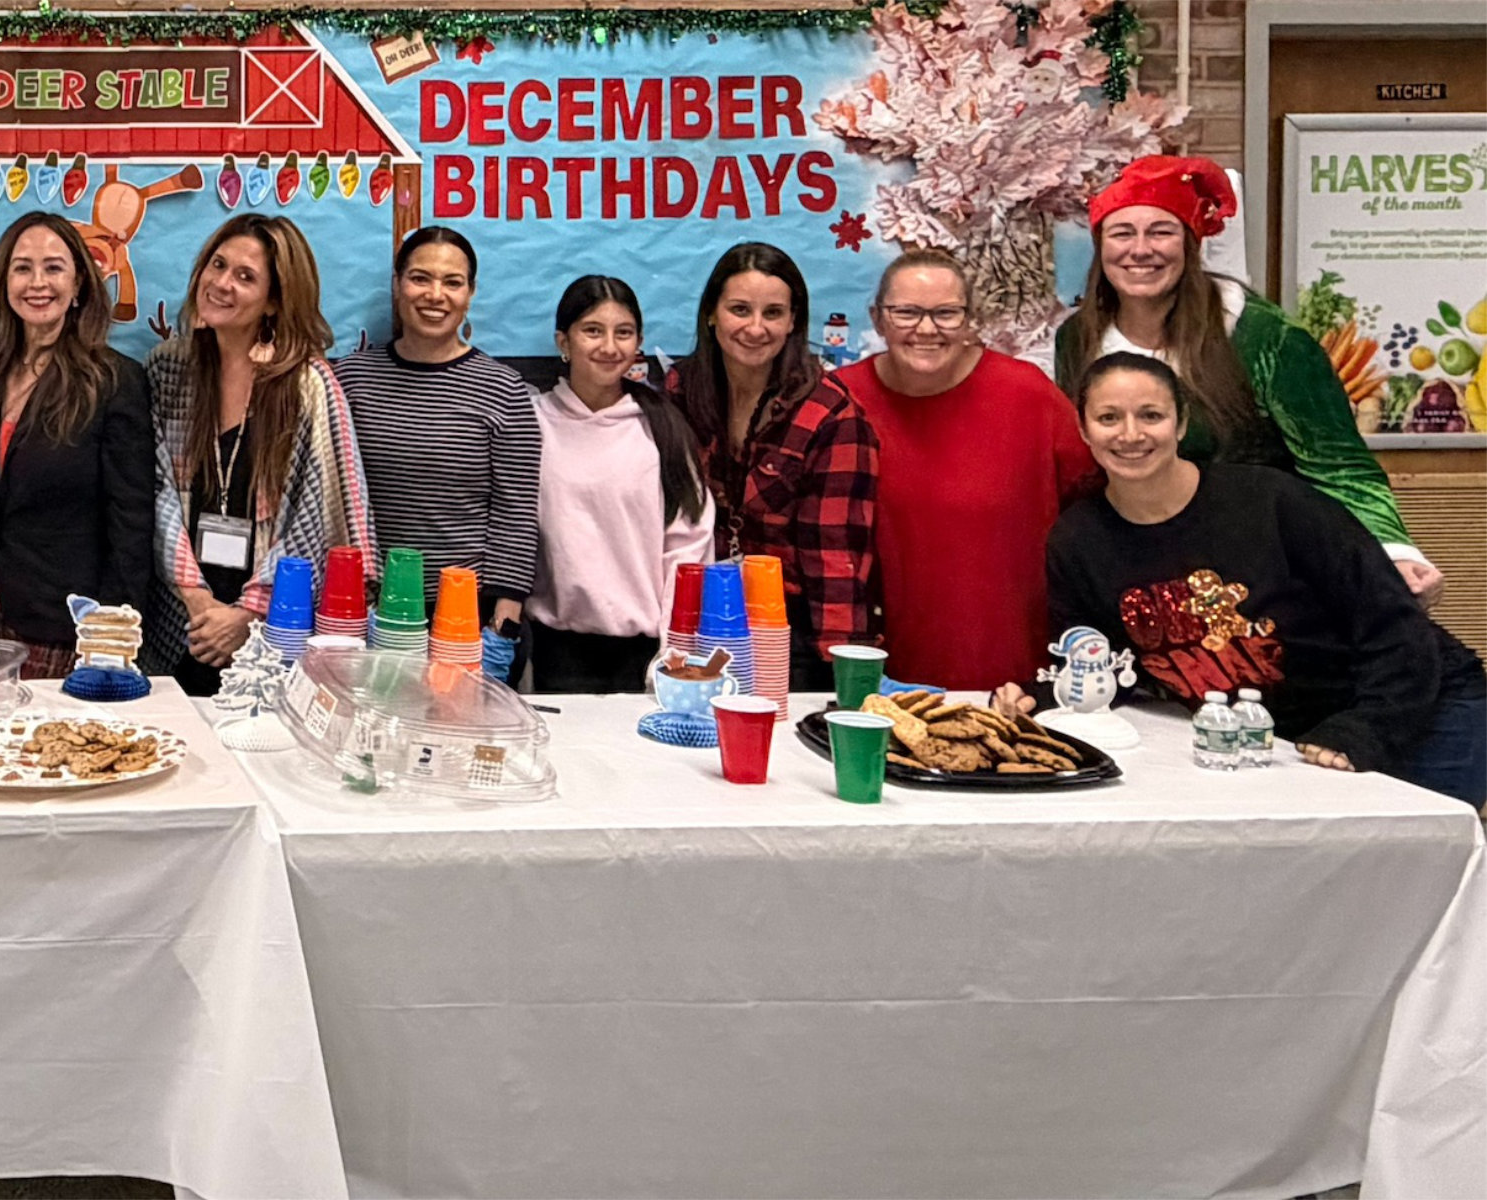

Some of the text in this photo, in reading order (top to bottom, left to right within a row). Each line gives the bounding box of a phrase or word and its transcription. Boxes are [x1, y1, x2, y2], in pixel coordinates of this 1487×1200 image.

[95, 68, 230, 110] STABLE
[1381, 84, 1441, 99] KITCHEN
[419, 75, 807, 146] DECEMBER
[433, 151, 837, 221] BIRTHDAYS
[1362, 196, 1462, 216] of the month
